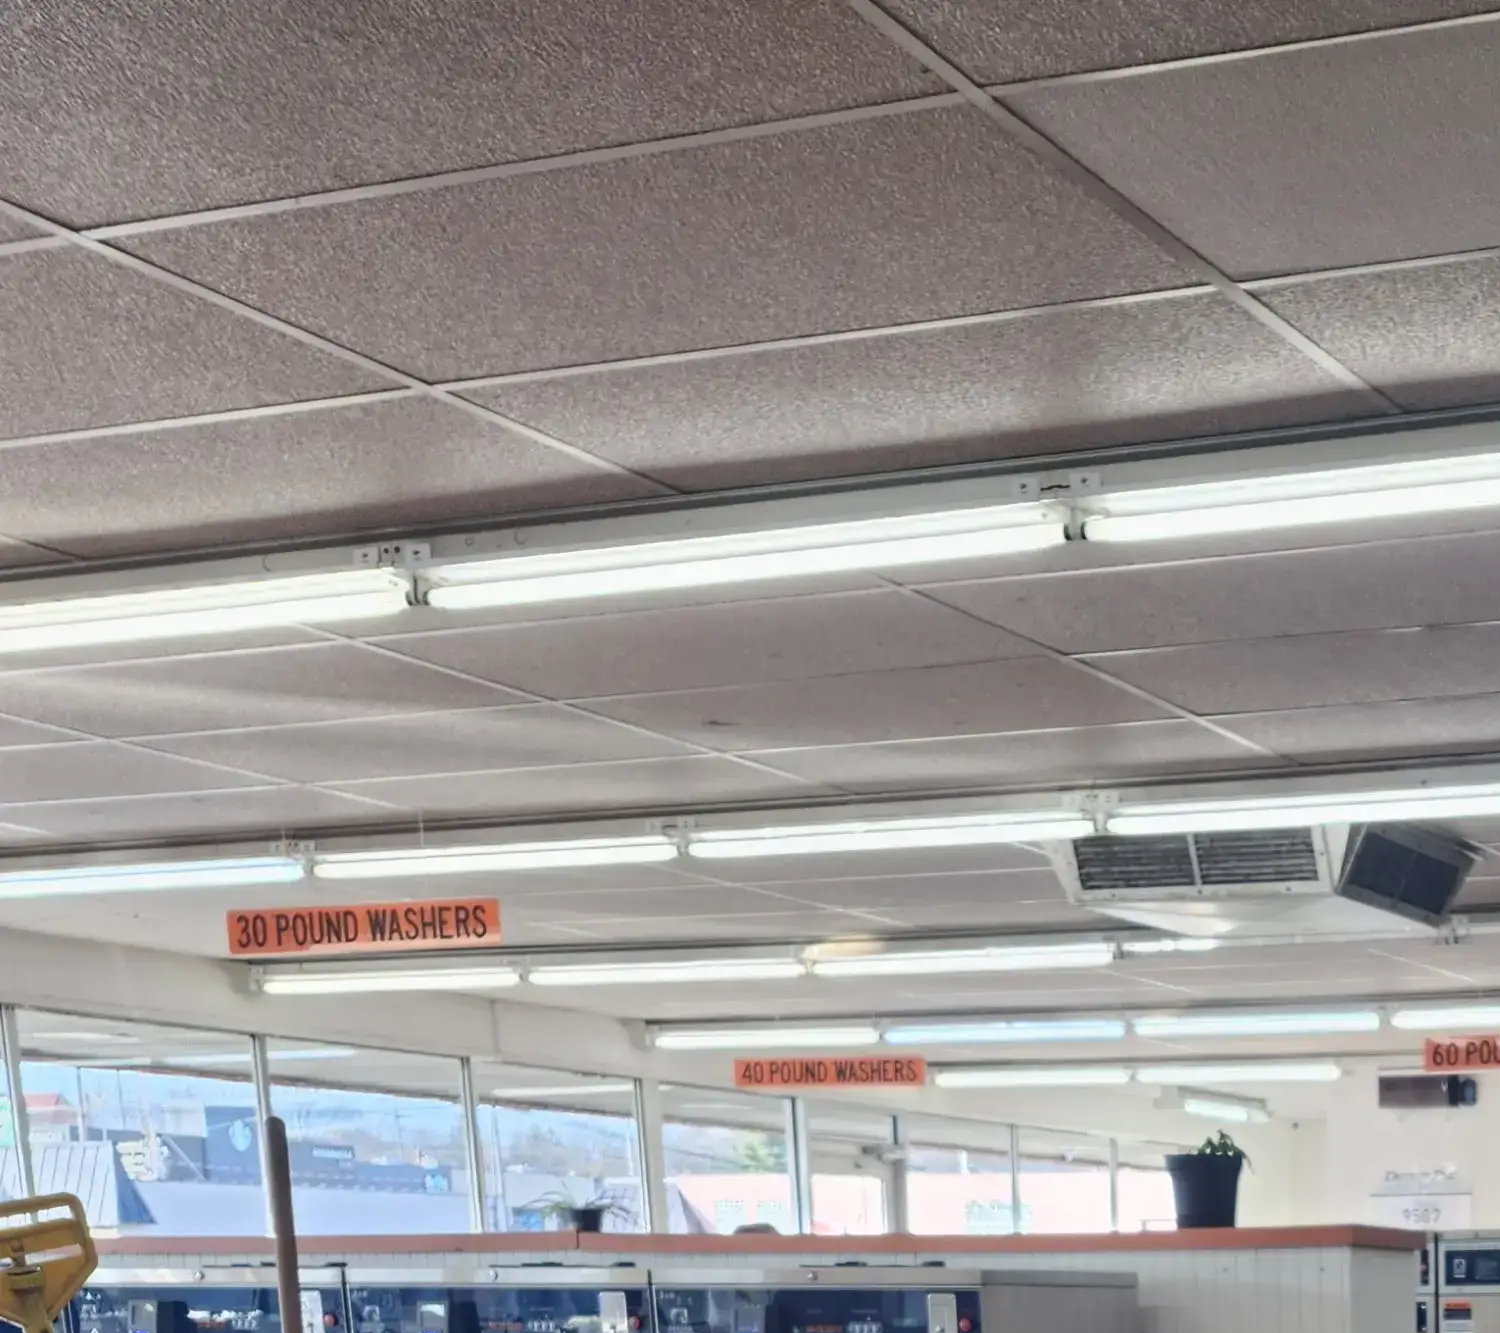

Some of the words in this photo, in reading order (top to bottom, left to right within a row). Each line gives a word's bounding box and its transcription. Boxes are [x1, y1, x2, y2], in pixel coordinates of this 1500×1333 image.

[237, 913, 267, 948] 30
[275, 909, 359, 947] POUND
[367, 904, 488, 942] WASHERS
[1432, 1041, 1459, 1066] 60
[741, 1061, 765, 1084] 40
[769, 1060, 828, 1083] POUND
[834, 1059, 918, 1082] WASHERS
